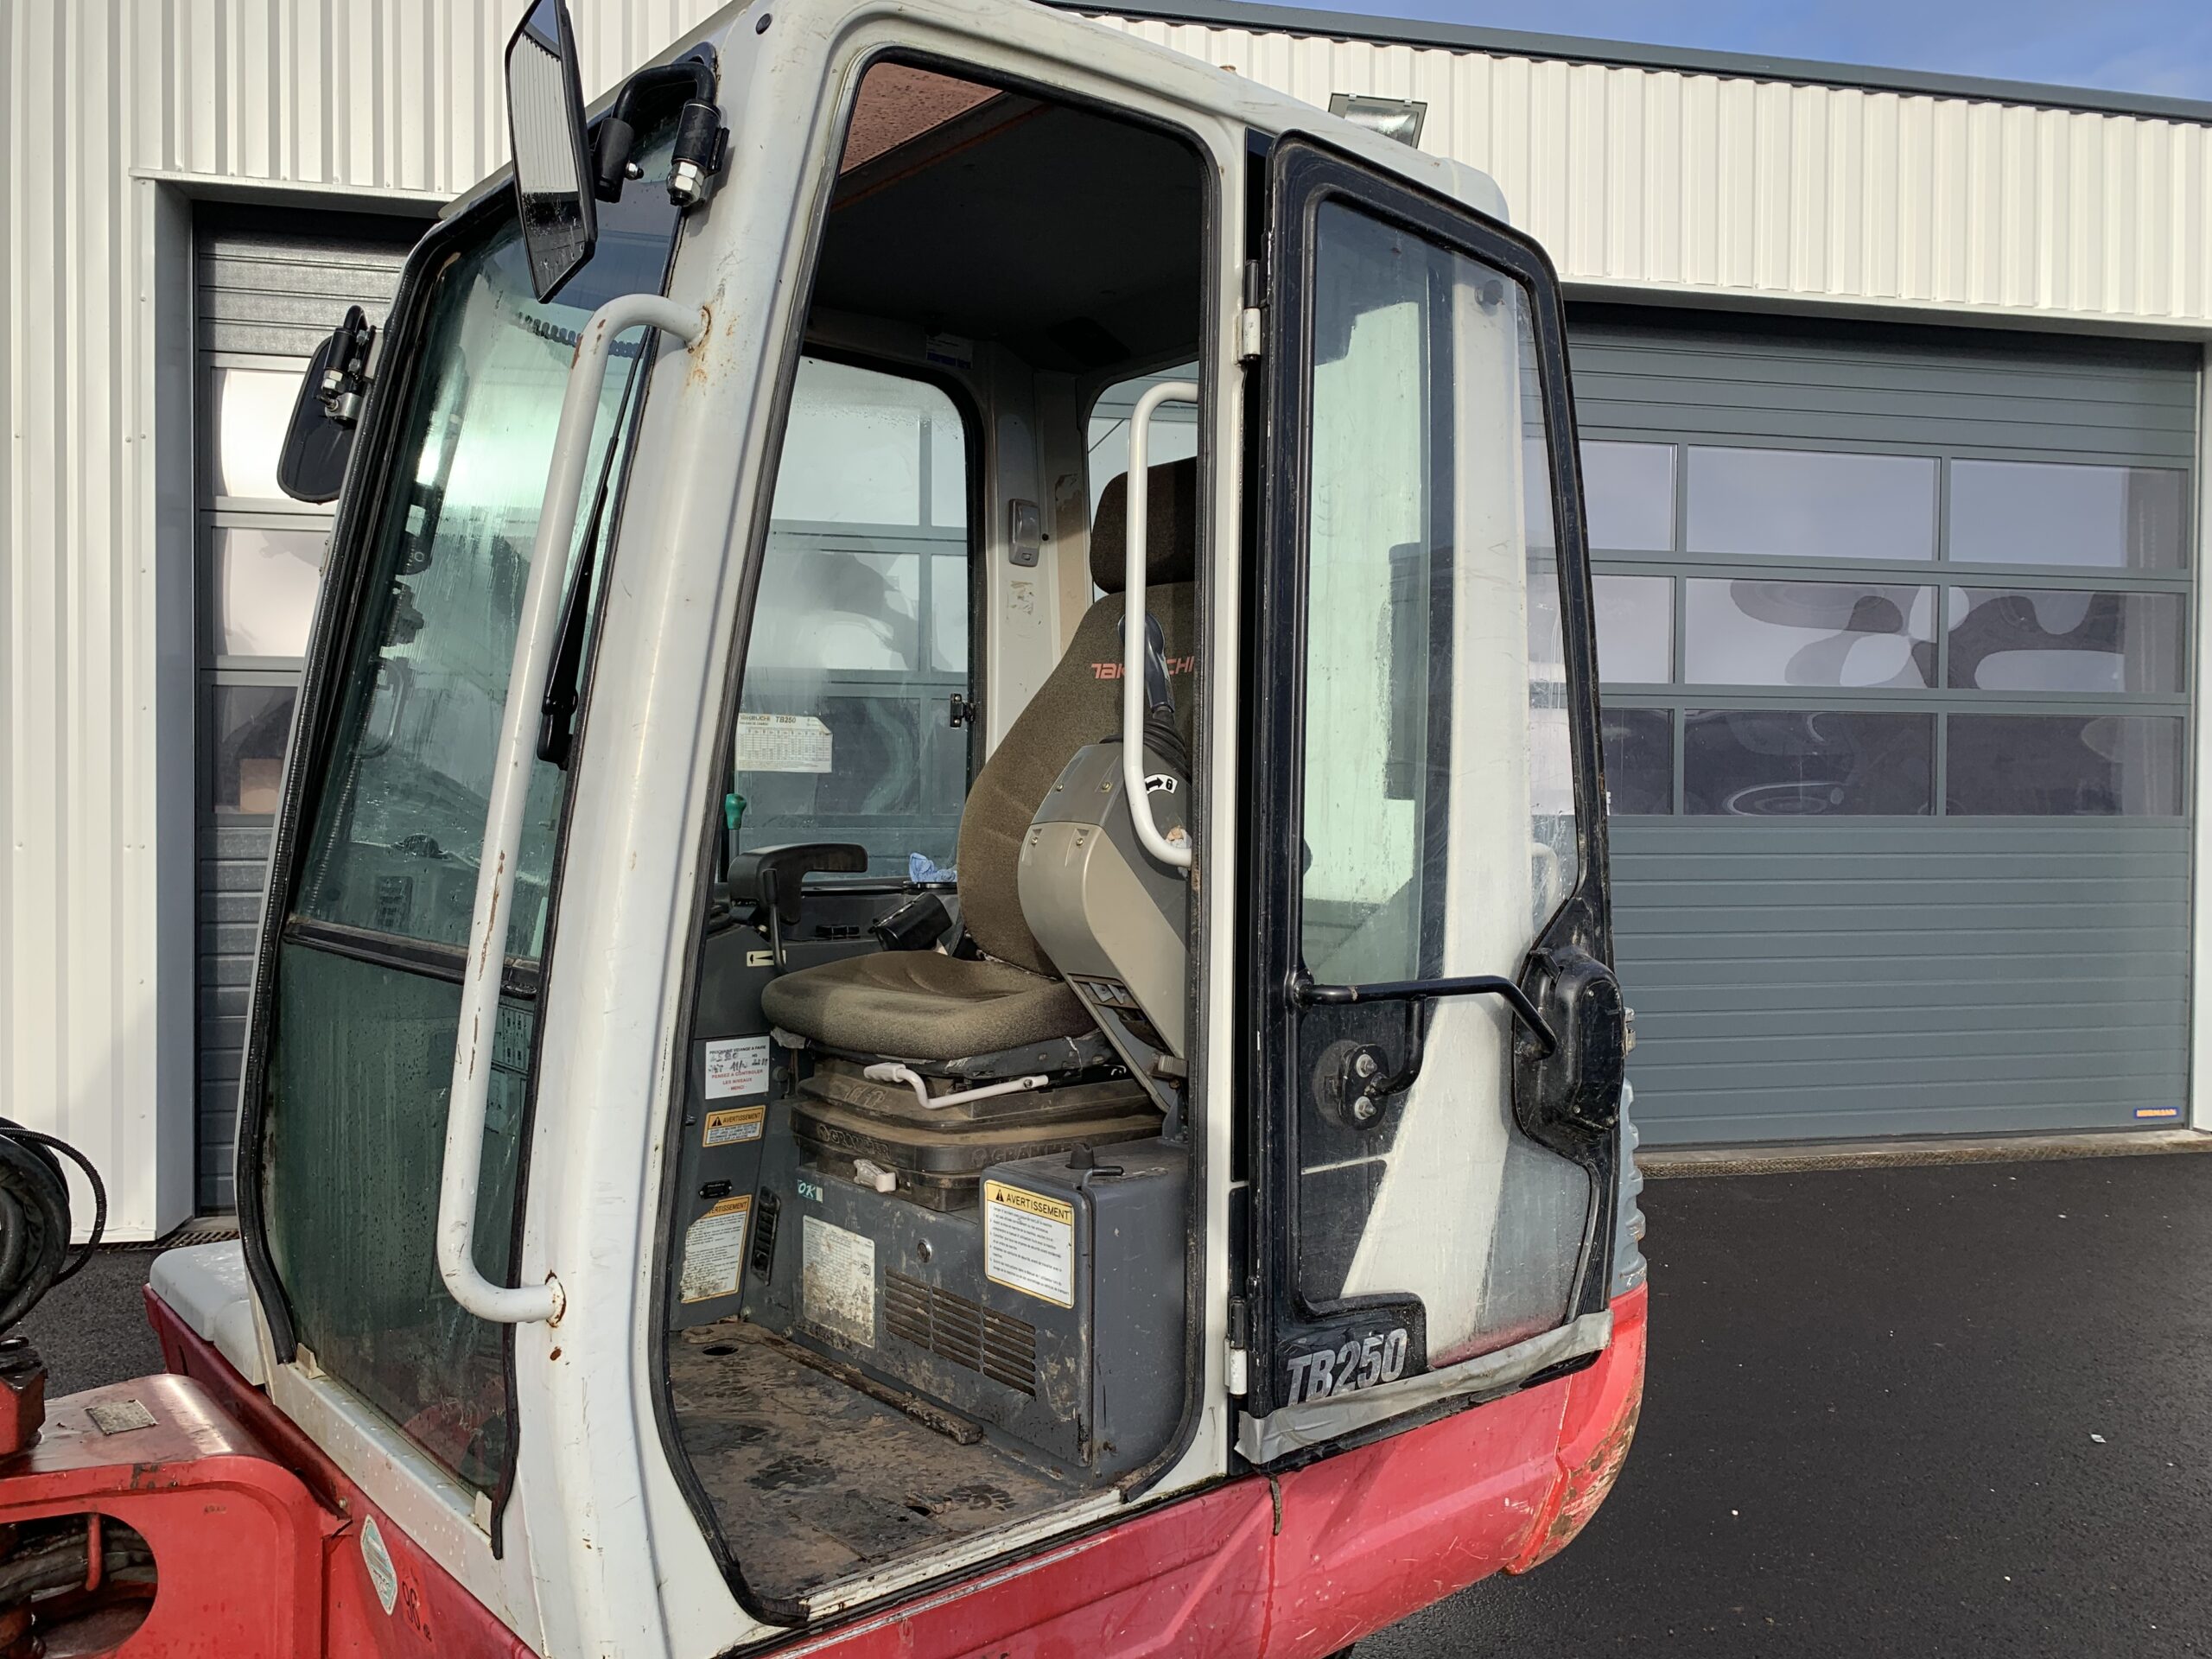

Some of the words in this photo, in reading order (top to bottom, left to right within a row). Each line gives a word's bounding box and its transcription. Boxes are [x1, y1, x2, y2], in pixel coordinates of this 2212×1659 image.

[1091, 656, 1195, 679] TAKCHI
[723, 1112, 760, 1123] AVERTISSEMENT
[798, 1183, 816, 1198] OK
[1007, 1192, 1069, 1220] AVERTISSEMENT
[1287, 1328, 1408, 1406] TB250
